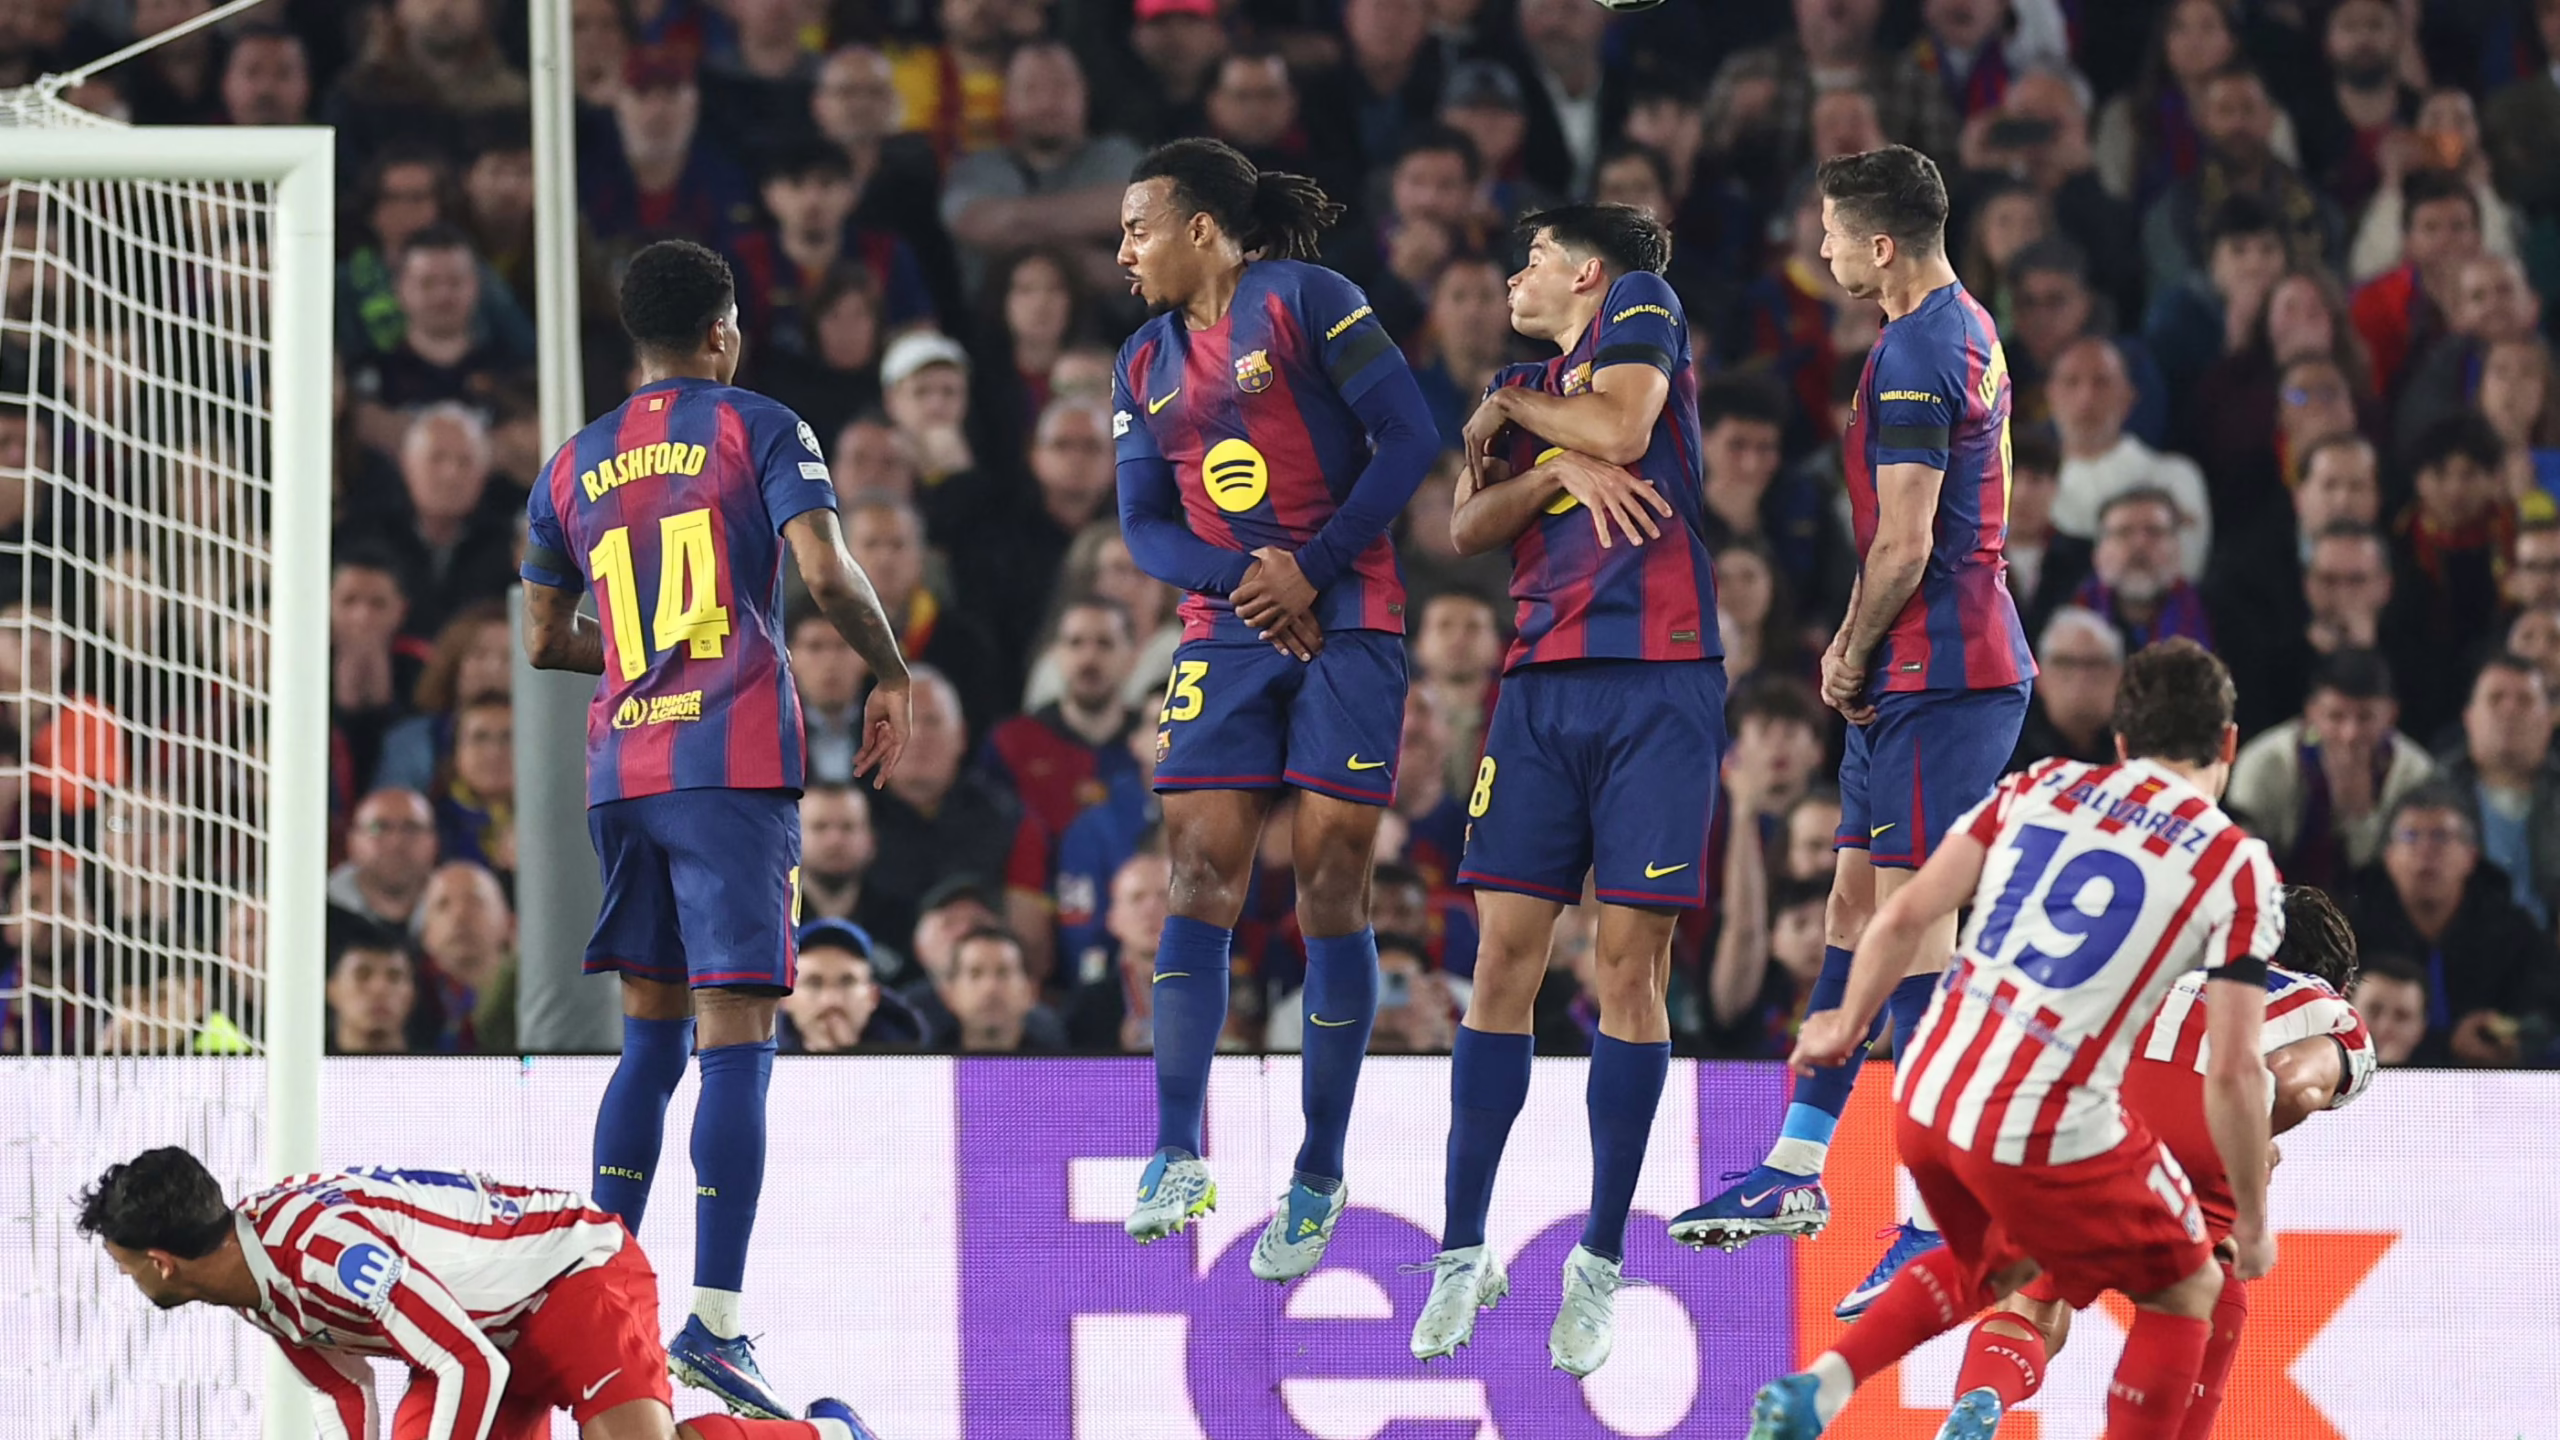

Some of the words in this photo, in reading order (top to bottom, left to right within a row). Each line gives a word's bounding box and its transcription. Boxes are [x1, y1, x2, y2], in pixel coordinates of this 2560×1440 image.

[1612, 304, 1670, 324] AMBILIGHT
[581, 442, 707, 503] RASHFORD
[588, 508, 731, 682] 14
[648, 702, 701, 720] ACNUR
[650, 690, 702, 710] UNHCR
[1469, 756, 1497, 818] 8
[2069, 783, 2208, 854] ALVAREZ
[1976, 823, 2146, 989] 19
[1984, 1344, 2036, 1387] ATLETI
